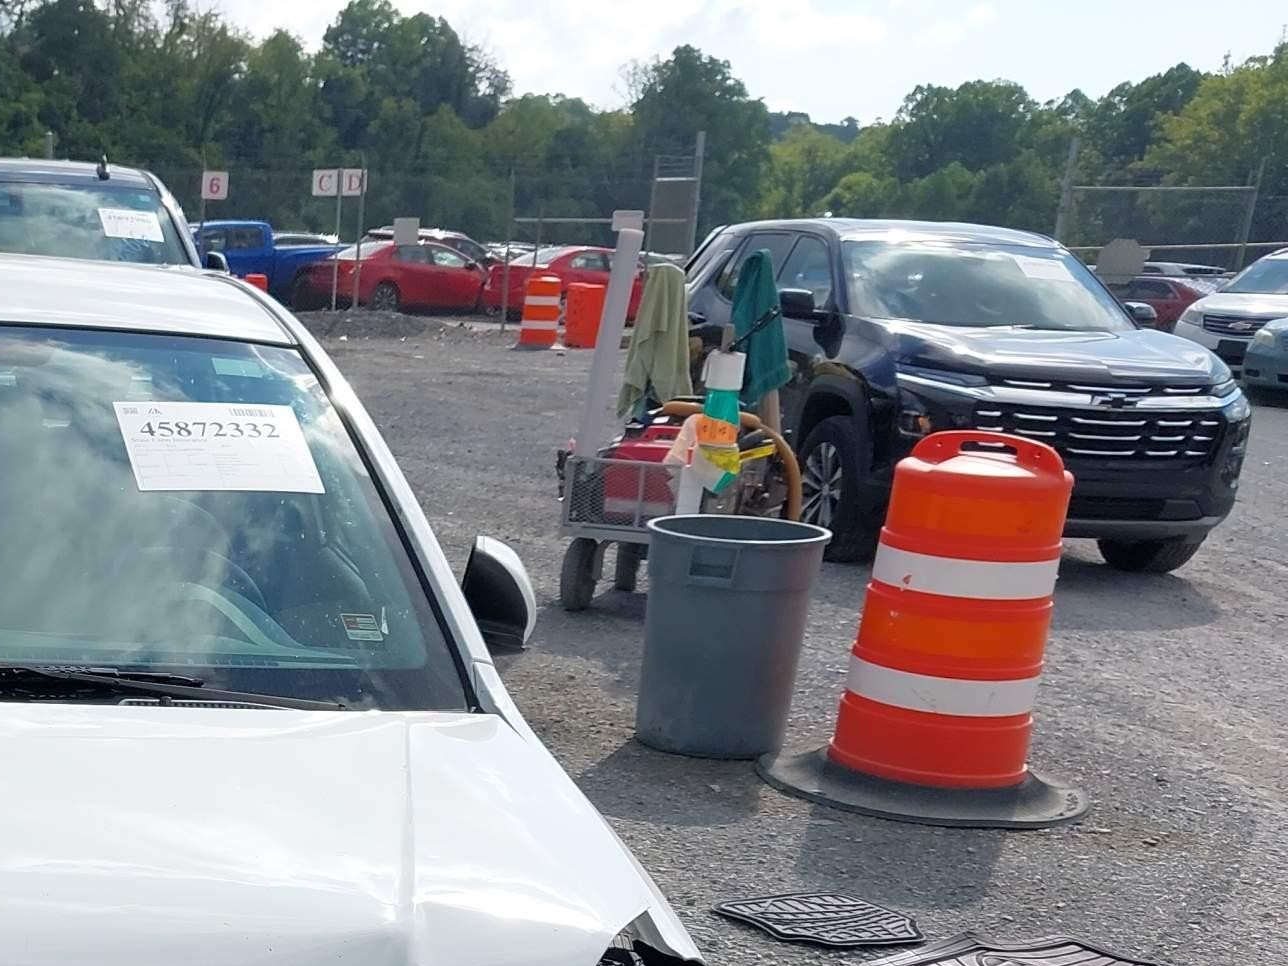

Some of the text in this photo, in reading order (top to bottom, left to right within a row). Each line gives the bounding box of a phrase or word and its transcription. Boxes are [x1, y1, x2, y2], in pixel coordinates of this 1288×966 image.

[208, 177, 221, 194] 6
[318, 174, 332, 192] C
[348, 174, 362, 191] D
[139, 420, 280, 439] 45872332
